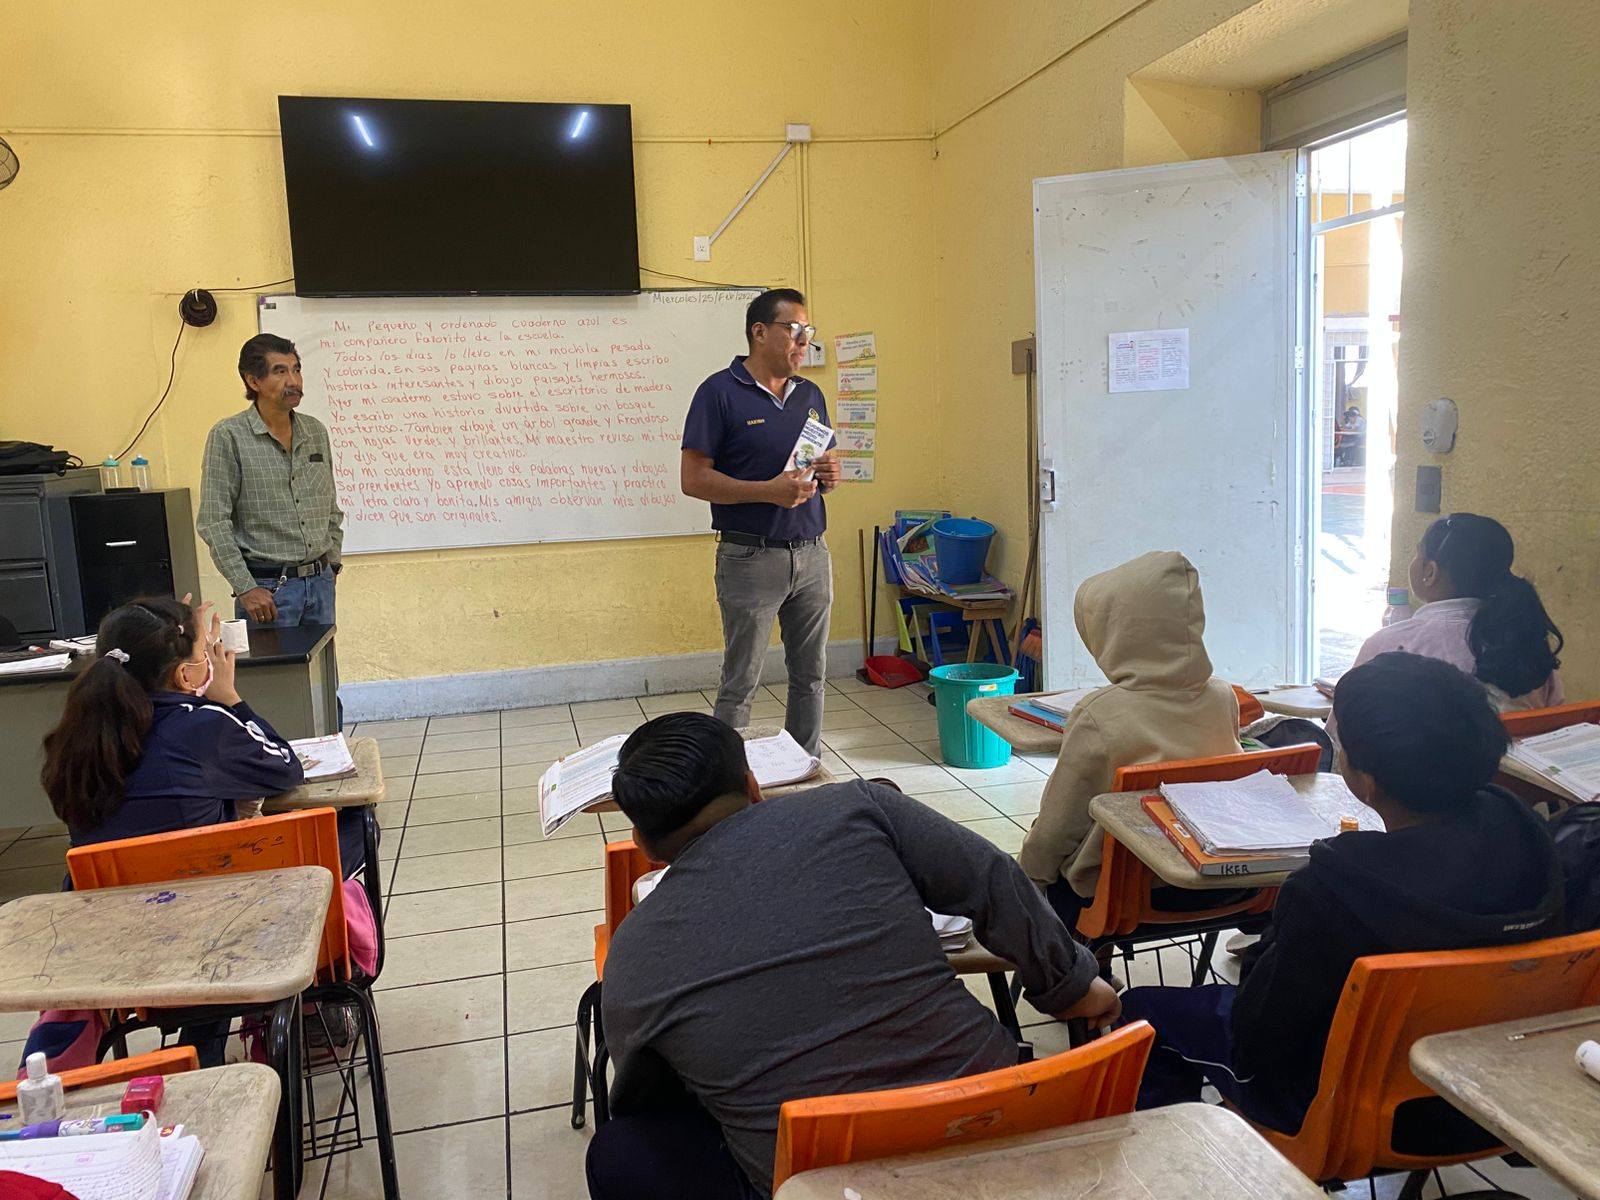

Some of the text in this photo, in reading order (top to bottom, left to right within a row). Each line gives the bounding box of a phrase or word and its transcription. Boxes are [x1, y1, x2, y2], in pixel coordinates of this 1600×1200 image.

[334, 321, 350, 332] Mi
[512, 314, 566, 328] cuaderno
[612, 318, 628, 326] es
[320, 339, 336, 348] mi
[475, 332, 492, 342] de
[500, 331, 511, 341] la
[444, 348, 456, 360] lo
[499, 348, 515, 357] en
[525, 347, 540, 357] mi
[394, 365, 413, 374] En
[362, 397, 376, 406] mi
[382, 394, 431, 404] cuaderno
[529, 387, 541, 397] el
[616, 383, 631, 394] de
[331, 411, 345, 422] Yo
[595, 403, 612, 413] un
[502, 421, 518, 430] un
[526, 434, 540, 445] Mi
[642, 431, 654, 441] mi
[659, 425, 682, 442] trab
[362, 466, 377, 477] mi
[384, 465, 434, 477] cuaderno
[508, 463, 521, 473] de
[427, 479, 441, 492] Yo
[341, 496, 354, 505] mi
[1220, 863, 1250, 876] IKER
